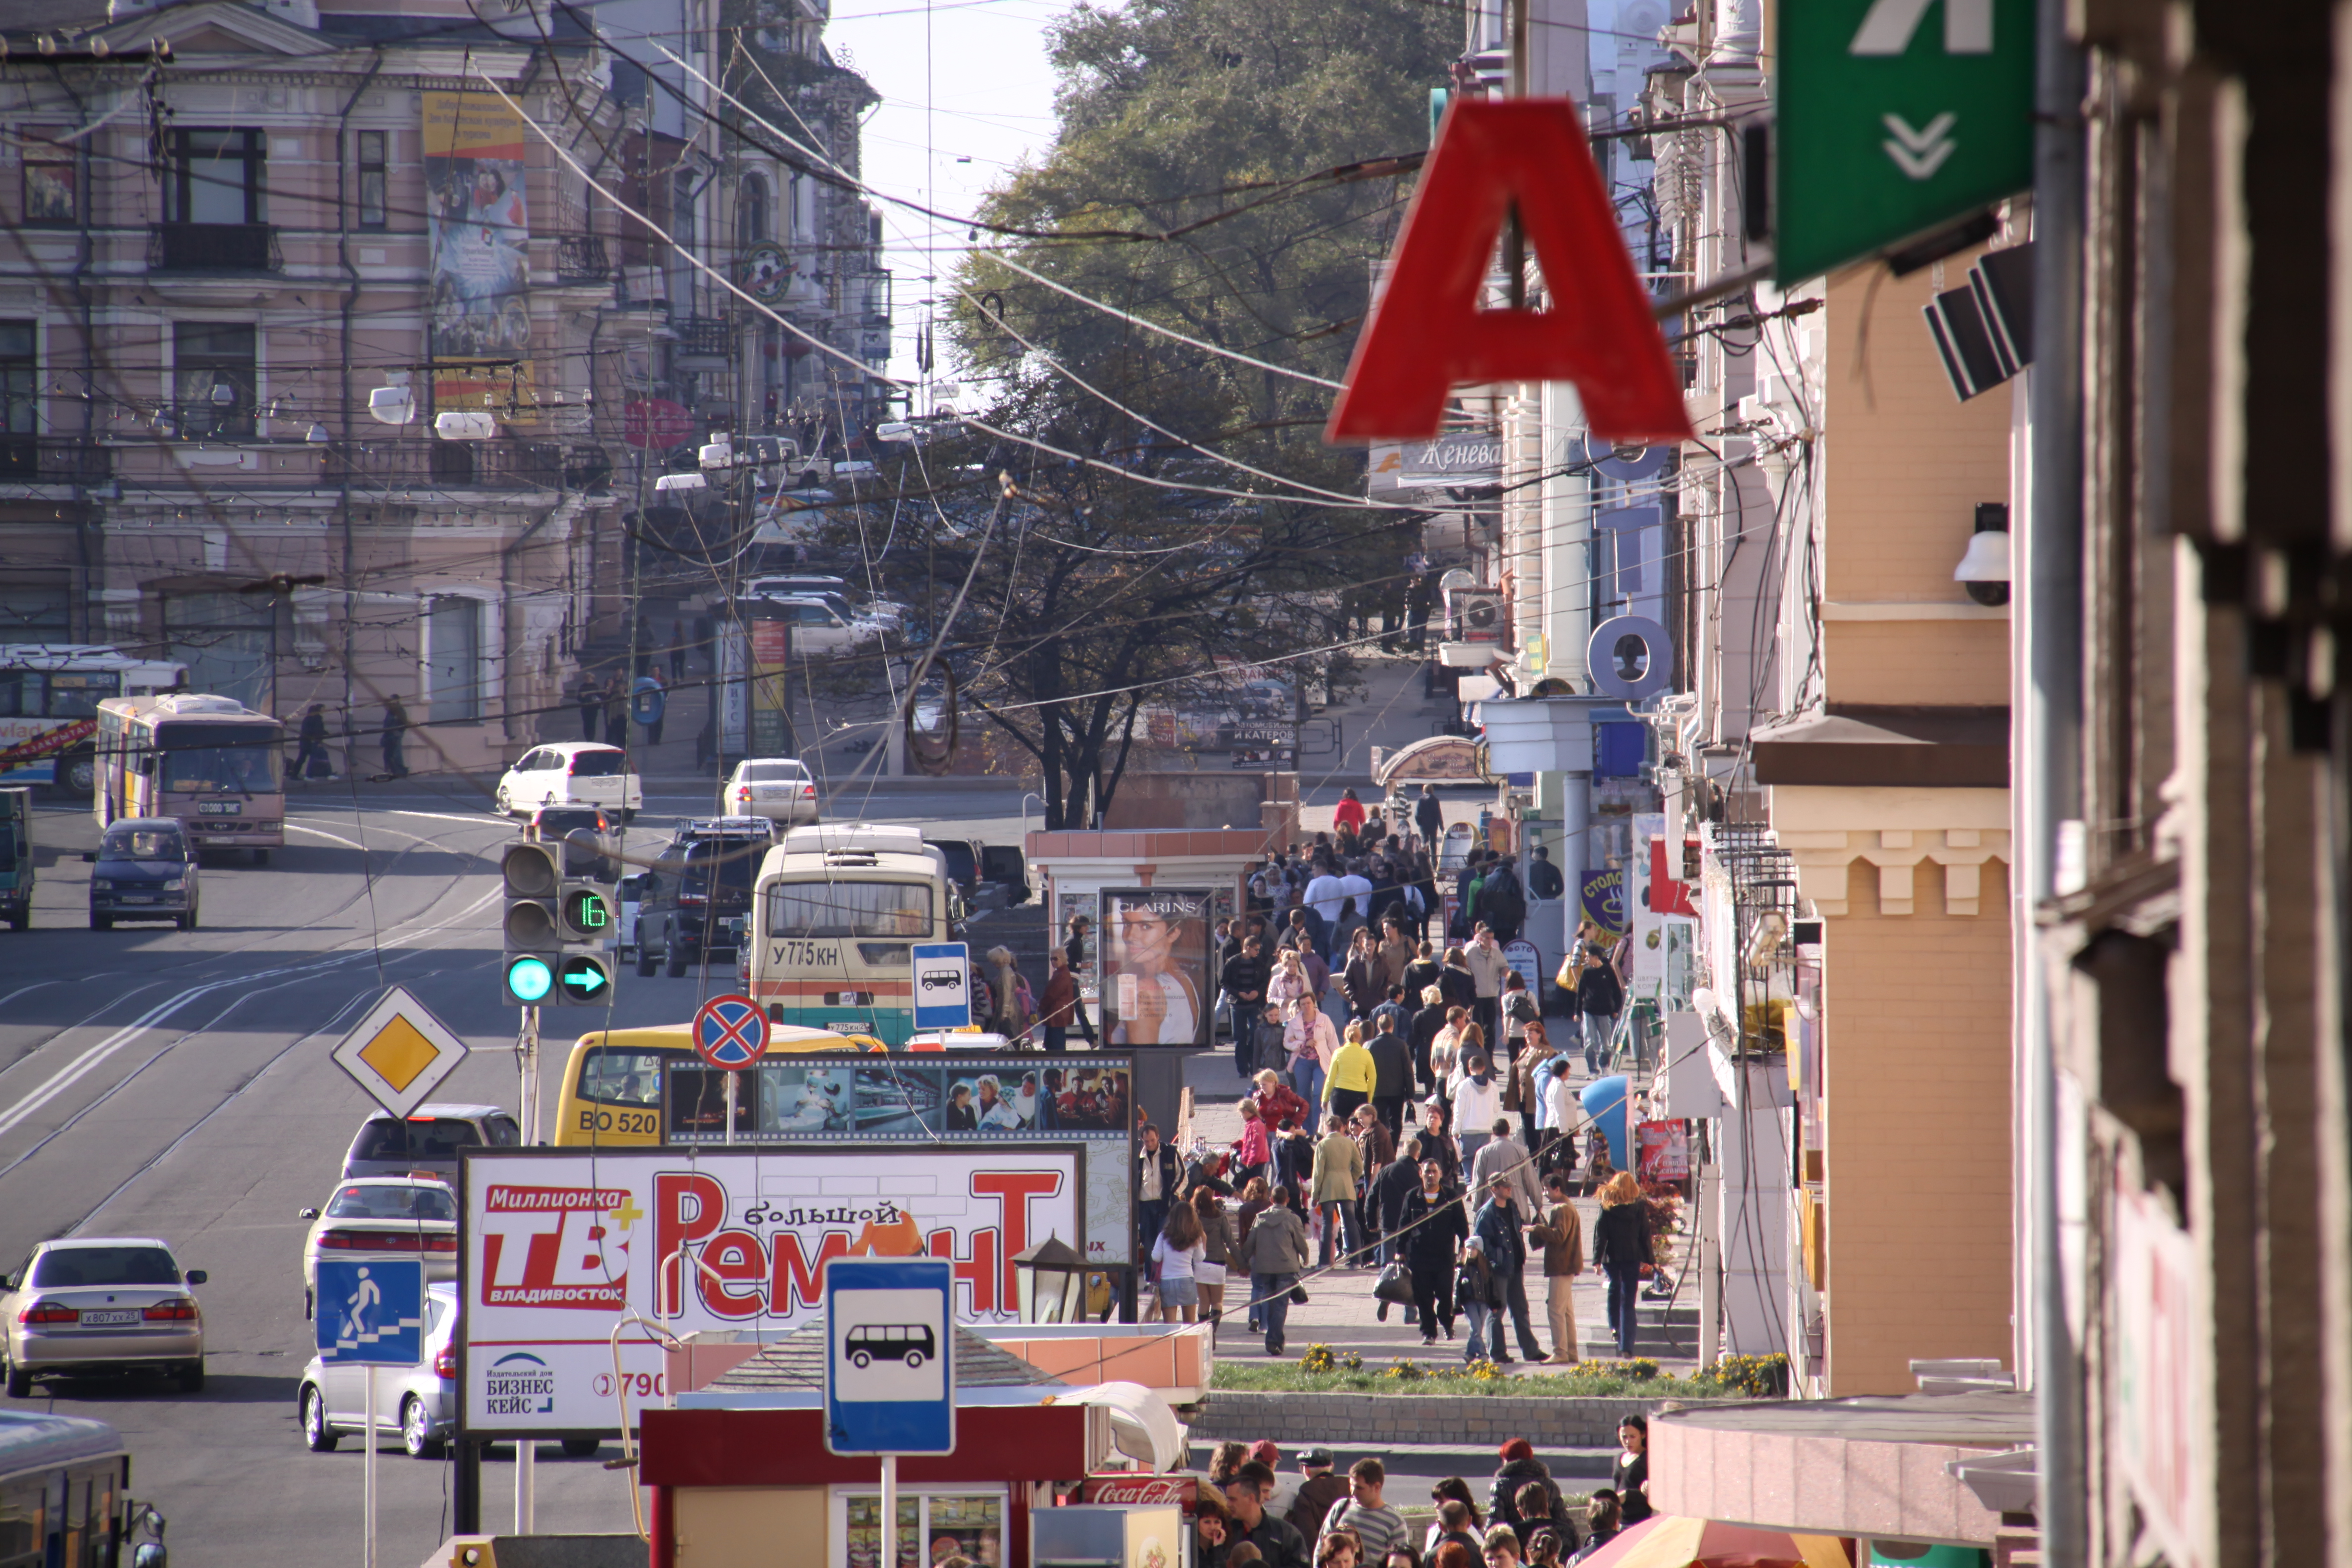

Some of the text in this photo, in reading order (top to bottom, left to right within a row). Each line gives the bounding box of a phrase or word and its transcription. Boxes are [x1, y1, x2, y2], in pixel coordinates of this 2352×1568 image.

[1419, 438, 1502, 470] Женева
[1234, 730, 1294, 739] И КАТЕРОВ
[583, 896, 605, 926] 16
[1119, 902, 1196, 913] CLARINS
[618, 1113, 656, 1134] 520
[490, 1188, 620, 1208] Миллионка
[744, 1200, 899, 1226] большой
[652, 1171, 1064, 1321] РемнТ
[490, 1288, 623, 1304] ВЛАДИВОСТОК
[487, 1369, 537, 1378] Издательский
[487, 1379, 554, 1396] БИЗНЕС
[487, 1396, 532, 1415] КЕЙС
[1093, 1480, 1186, 1504] Coca-Cola
